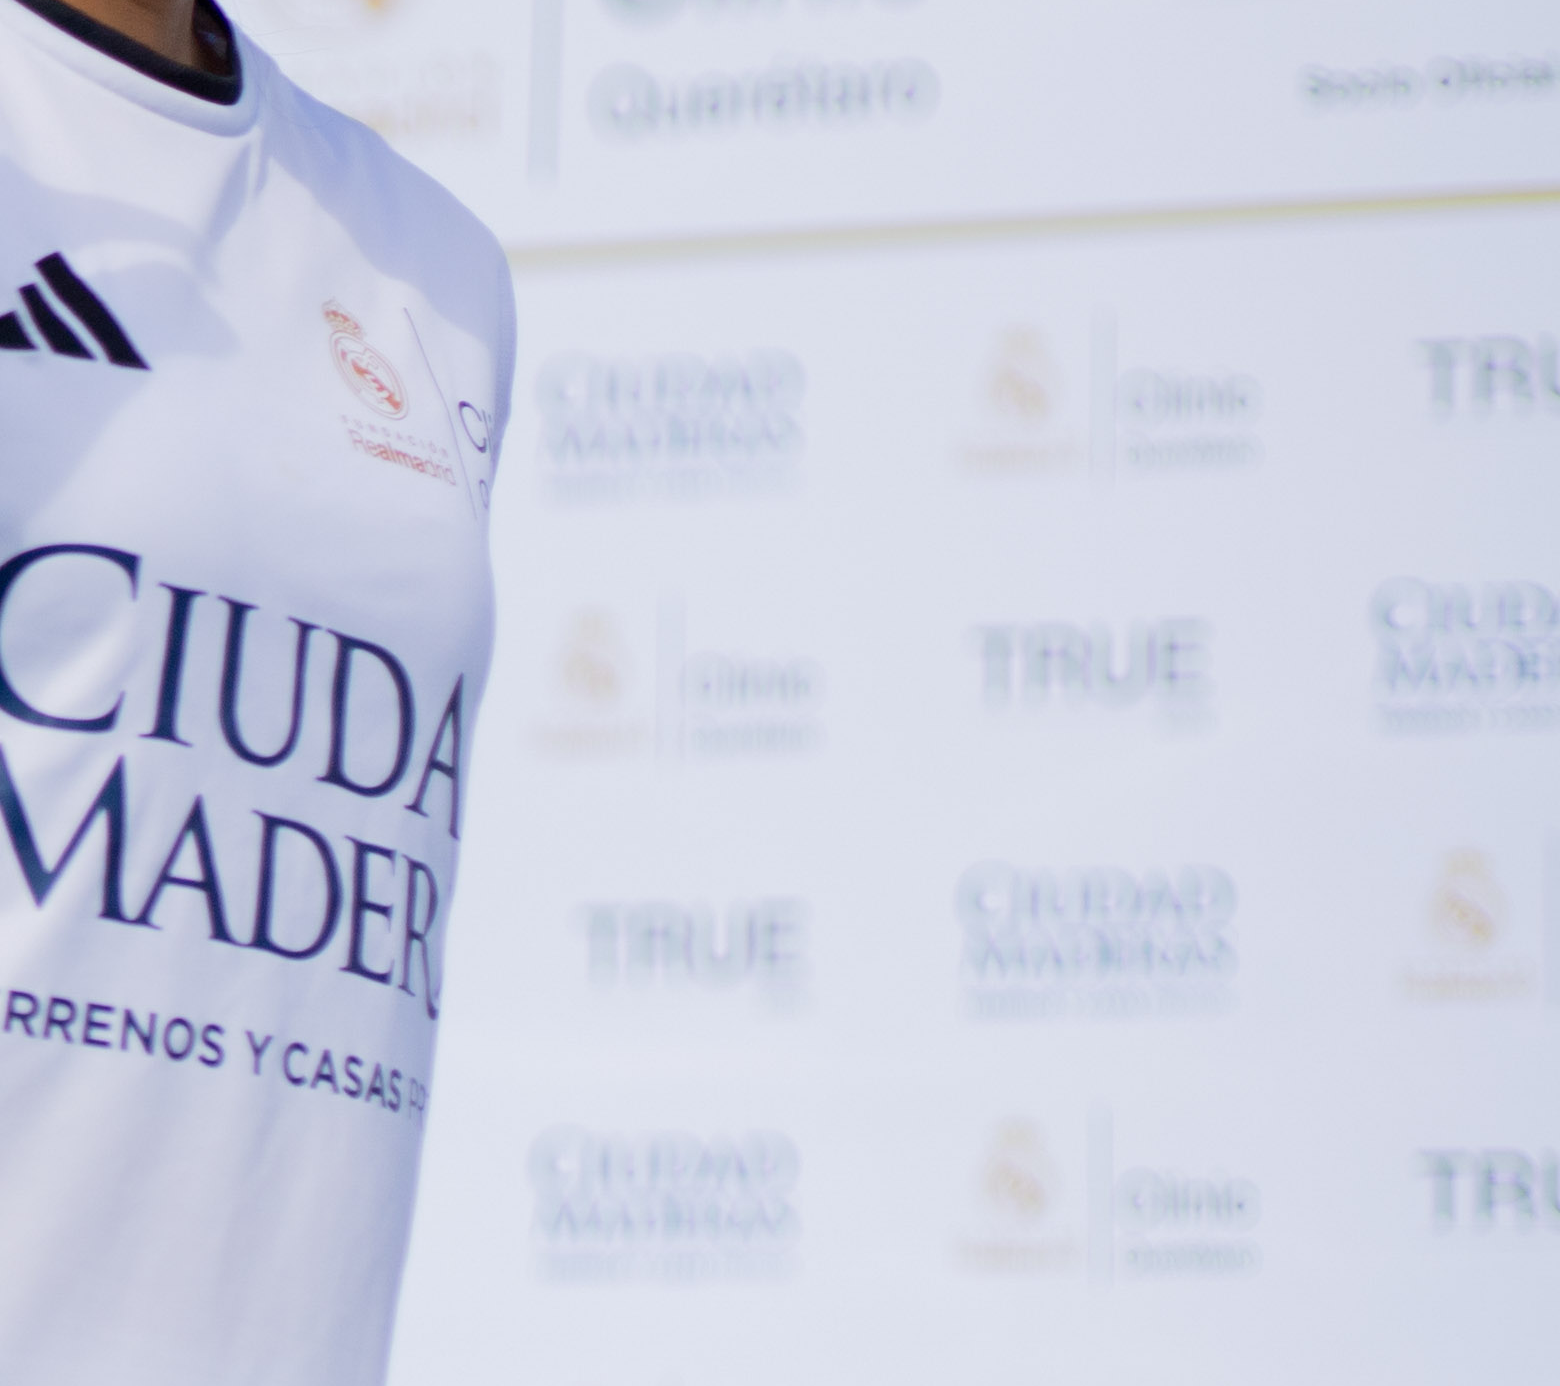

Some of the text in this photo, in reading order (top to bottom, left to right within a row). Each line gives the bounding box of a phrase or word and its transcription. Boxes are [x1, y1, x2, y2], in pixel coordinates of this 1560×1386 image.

[974, 613, 1212, 705] TRUE
[244, 1029, 273, 1076] Y
[283, 1041, 403, 1113] CASAS
